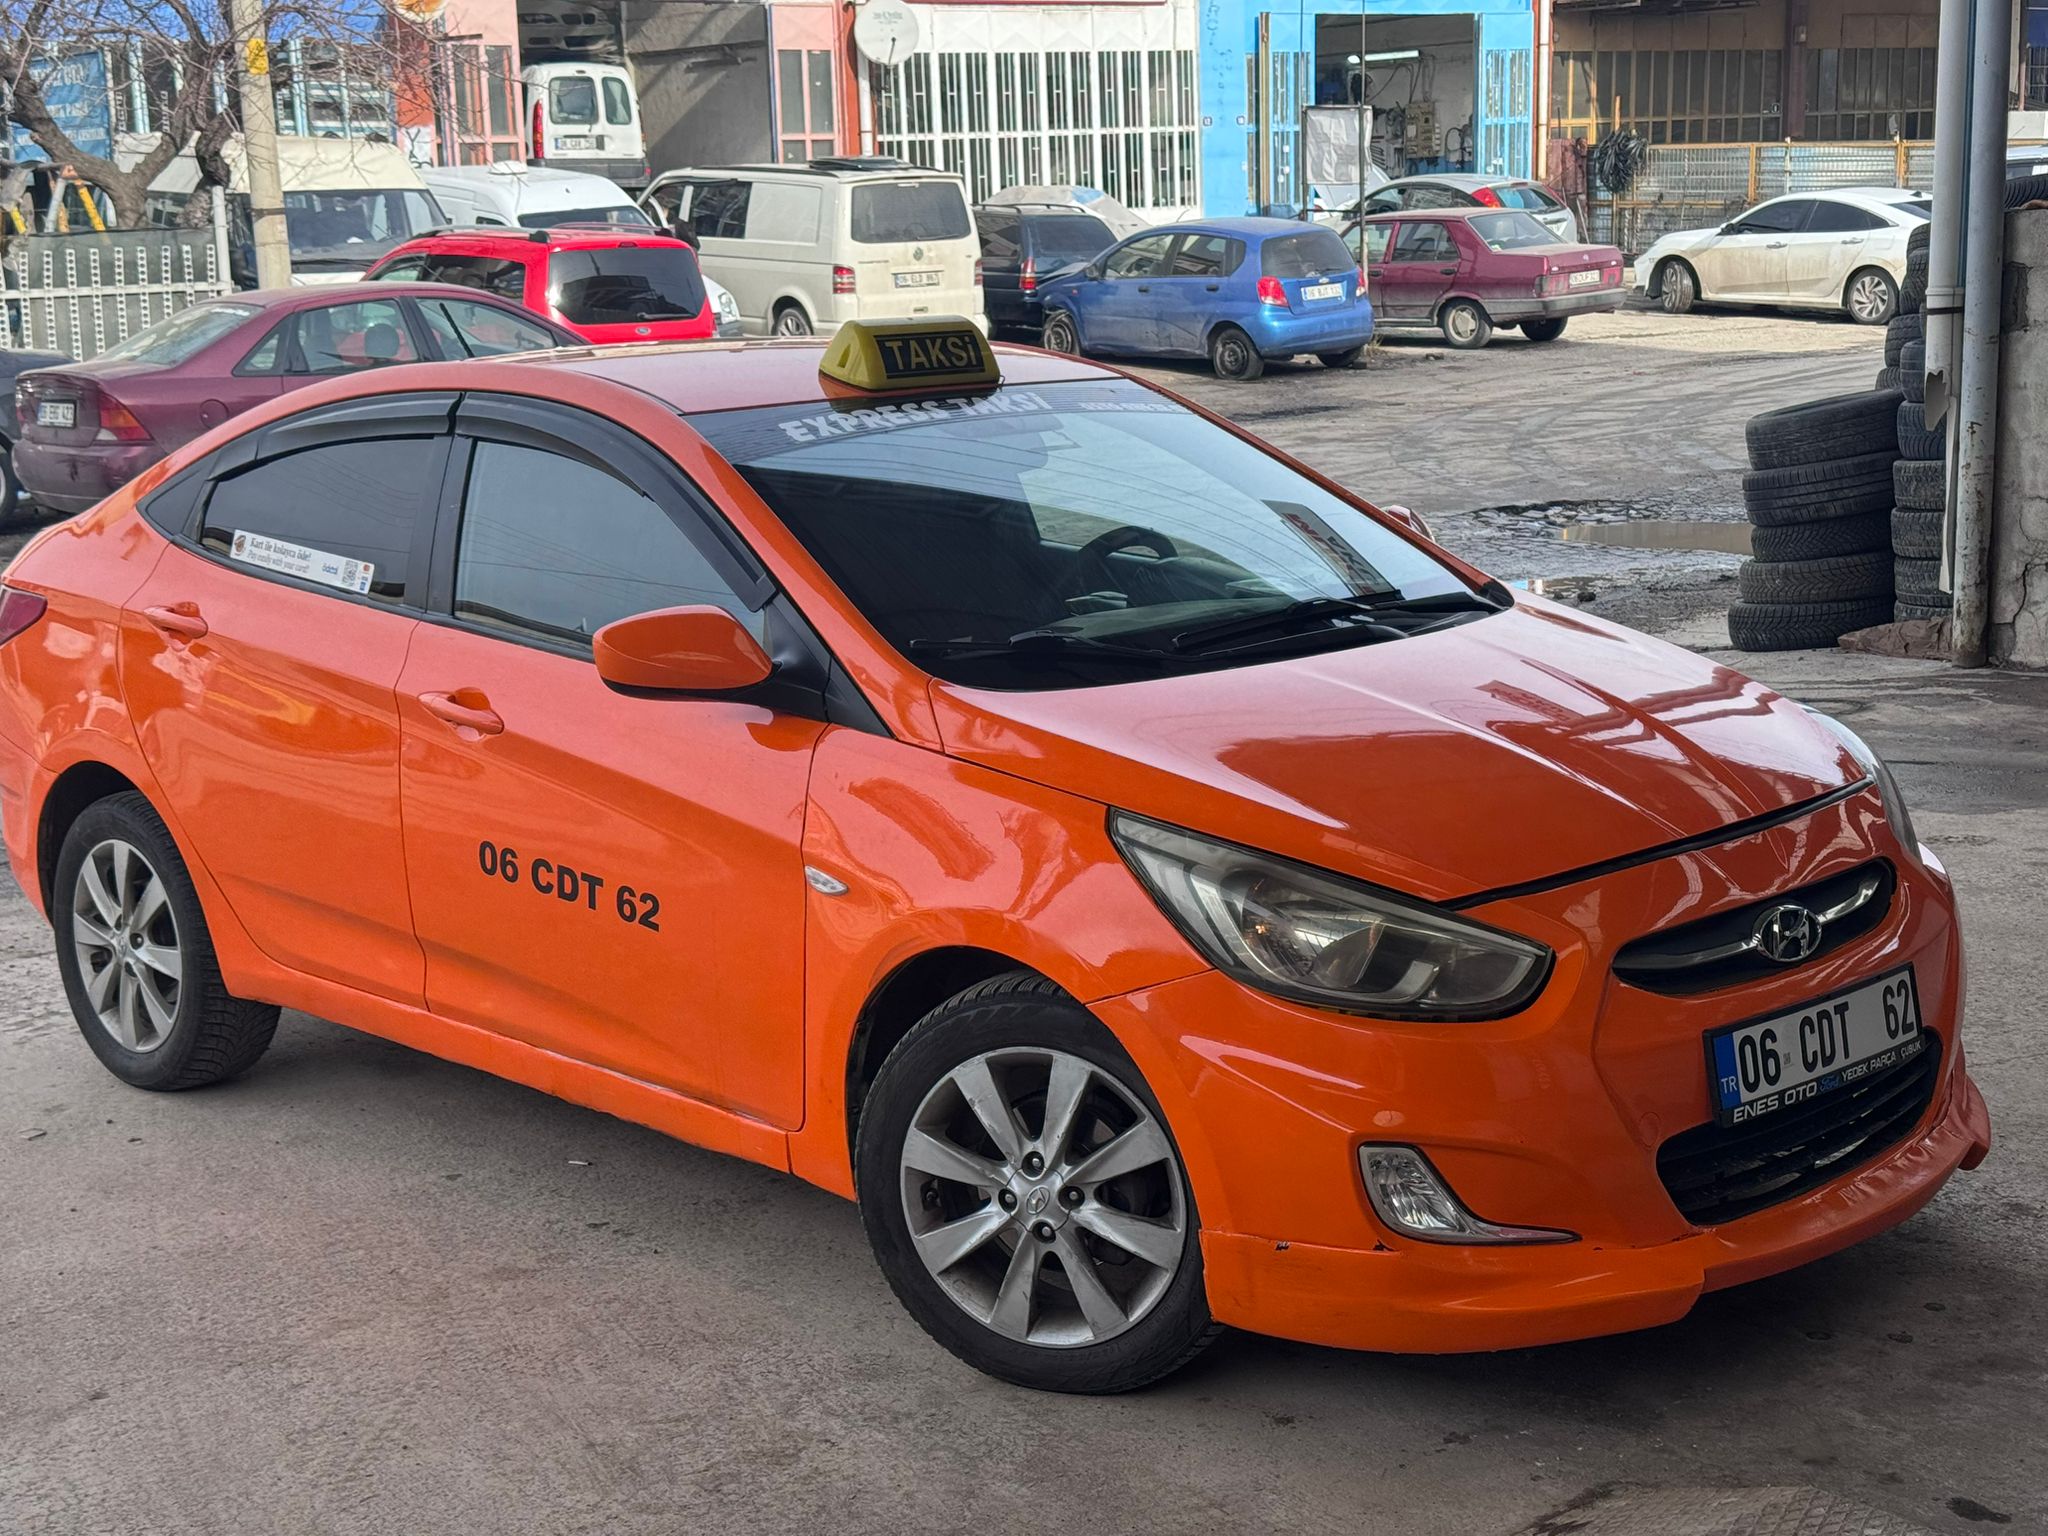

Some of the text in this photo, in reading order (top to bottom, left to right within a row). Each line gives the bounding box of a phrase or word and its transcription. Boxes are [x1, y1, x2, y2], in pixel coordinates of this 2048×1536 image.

[778, 399, 951, 442] EXPRESS
[478, 840, 660, 933] 06 CDT 62
[1738, 979, 1915, 1093] 06 CDT 62
[1721, 1075, 1738, 1095] TR
[1733, 1095, 1779, 1124] ENES
[1784, 1081, 1818, 1106] OTO
[1841, 1061, 1869, 1082] YEDEK
[1869, 1051, 1897, 1072] PARÇA
